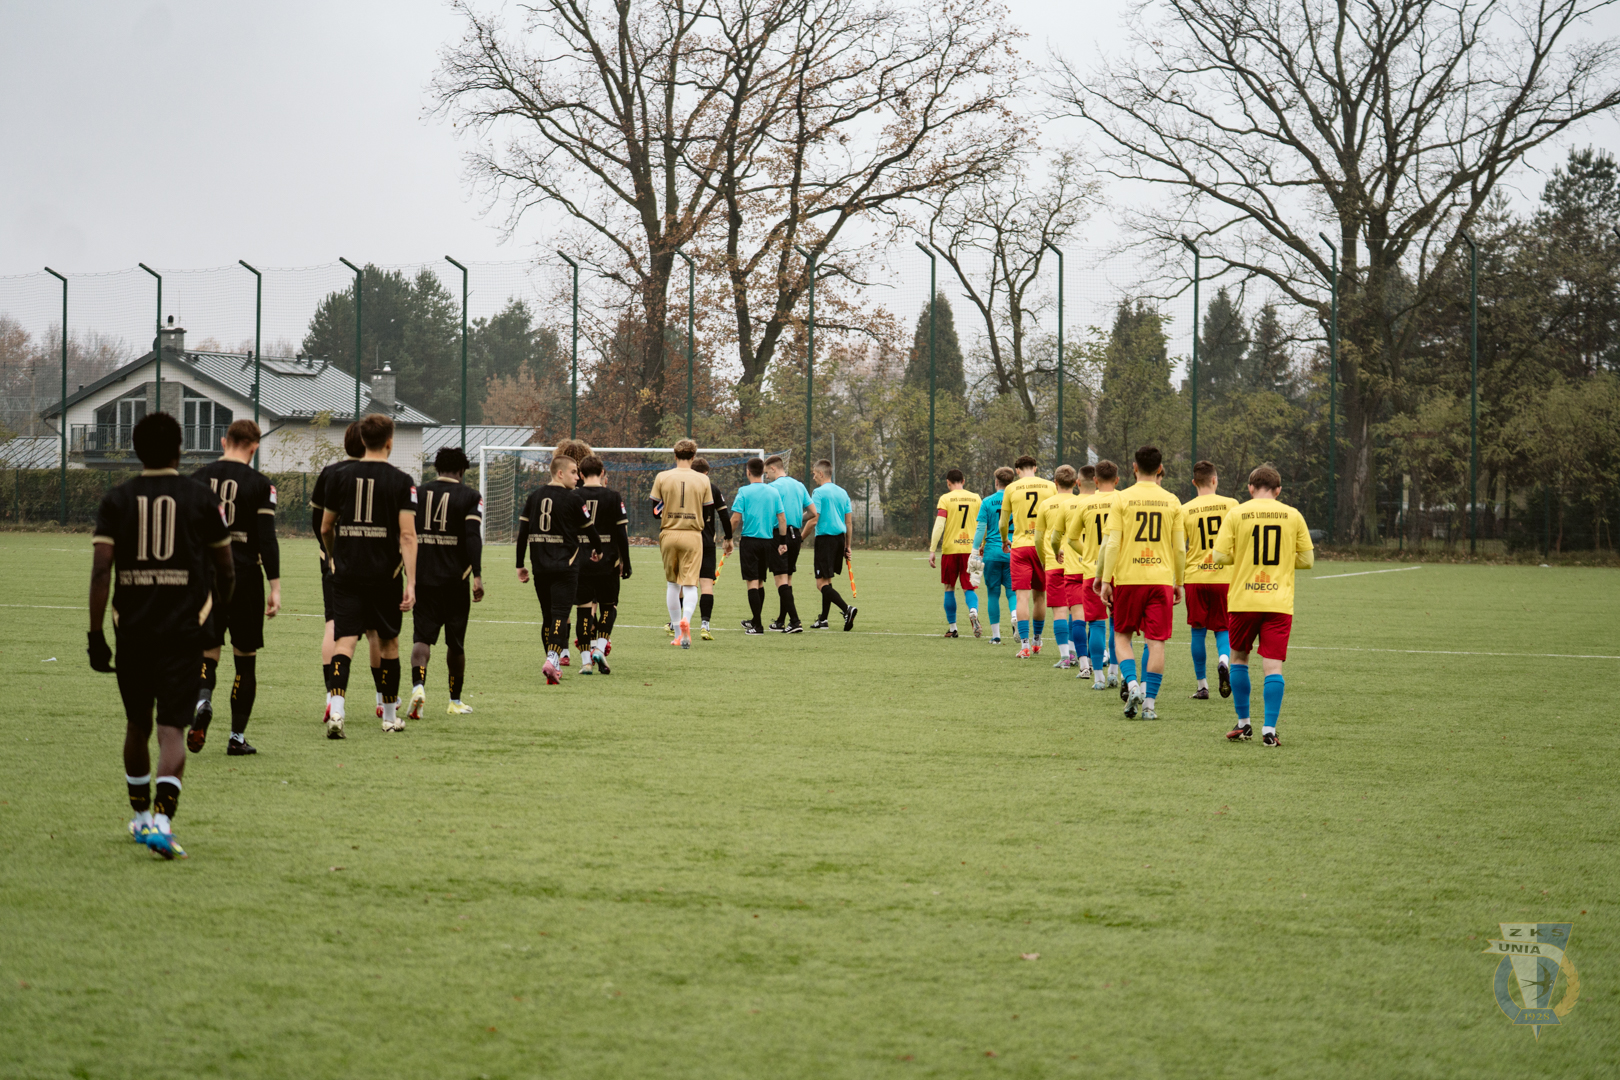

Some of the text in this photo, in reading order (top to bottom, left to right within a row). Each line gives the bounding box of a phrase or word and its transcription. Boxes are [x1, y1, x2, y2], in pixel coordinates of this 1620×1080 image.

[353, 477, 375, 523] 11
[424, 490, 450, 531] 14
[680, 481, 685, 508] 1
[1026, 492, 1038, 518] 2
[136, 495, 176, 561] 10
[539, 498, 553, 532] 8
[958, 505, 969, 529] 7
[1135, 511, 1162, 542] 20
[1252, 525, 1281, 565] 10
